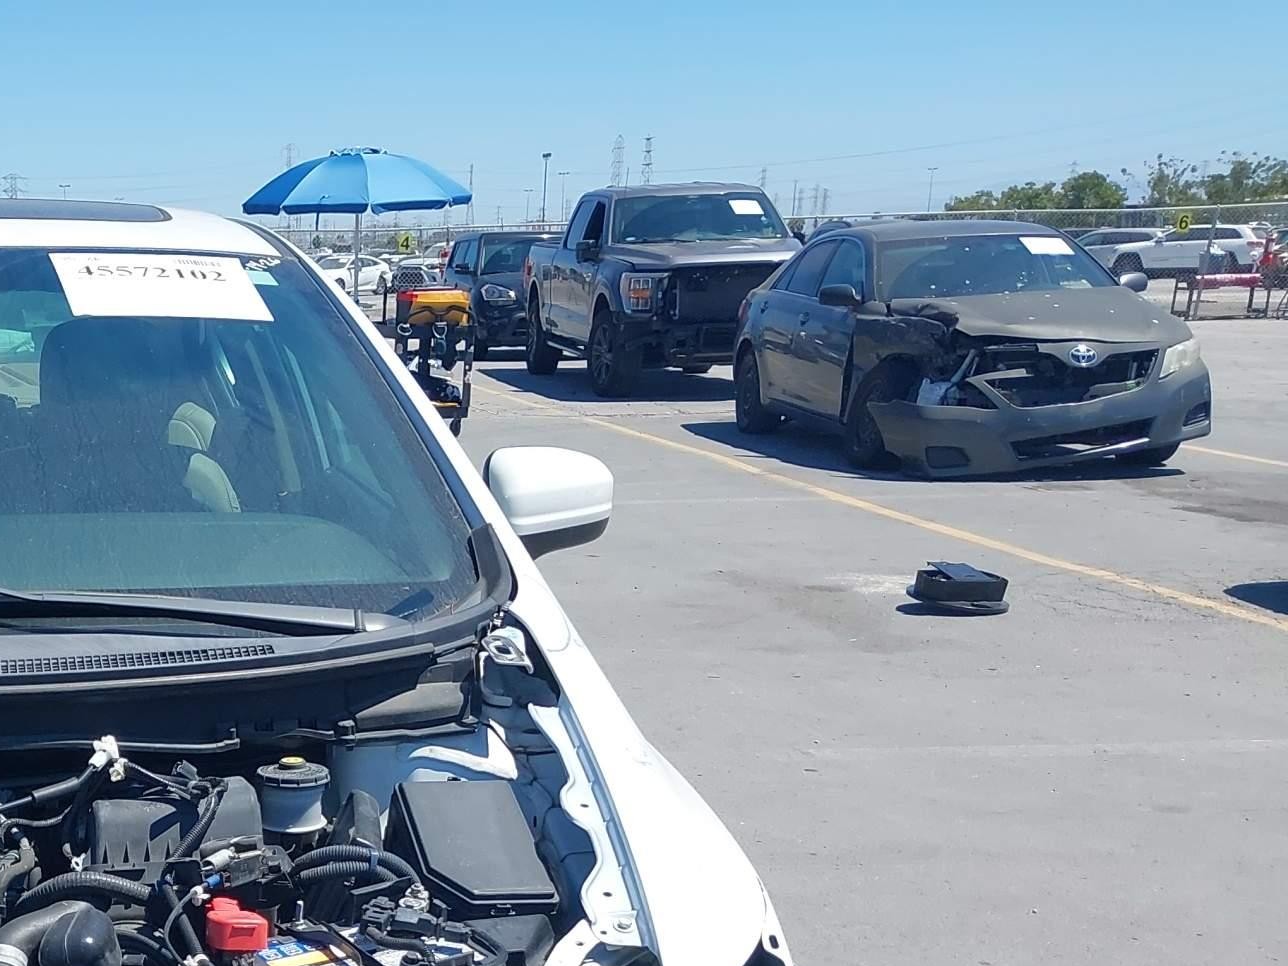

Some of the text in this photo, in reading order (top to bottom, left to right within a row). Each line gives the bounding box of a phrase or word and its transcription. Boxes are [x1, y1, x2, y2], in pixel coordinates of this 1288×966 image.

[1178, 215, 1190, 230] 6
[400, 236, 410, 251] 4
[77, 264, 227, 282] 45572102
